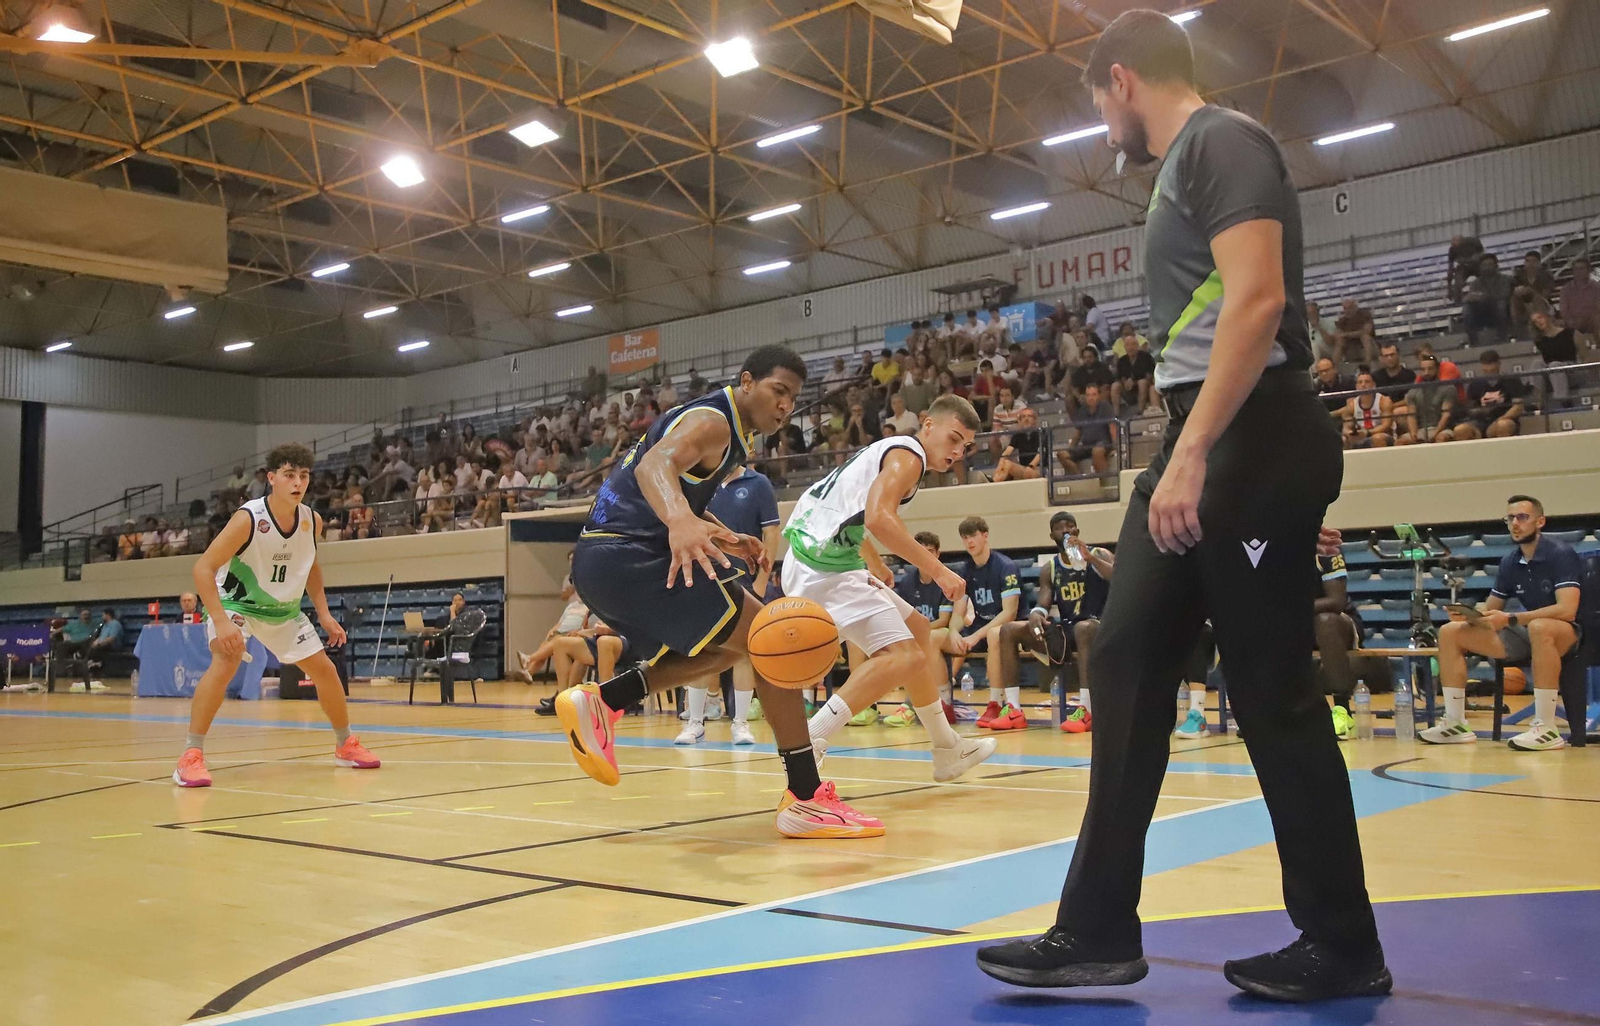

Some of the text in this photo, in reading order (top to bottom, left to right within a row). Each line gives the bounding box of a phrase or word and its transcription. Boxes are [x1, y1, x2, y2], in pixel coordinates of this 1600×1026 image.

[1335, 192, 1348, 214] C
[1013, 246, 1132, 289] FUMAR
[804, 299, 812, 318] B
[624, 334, 643, 348] Bar
[512, 357, 519, 372] A
[1331, 553, 1345, 570] 25
[270, 564, 287, 583] 18
[1005, 574, 1018, 587] 35
[974, 587, 995, 606] CBA
